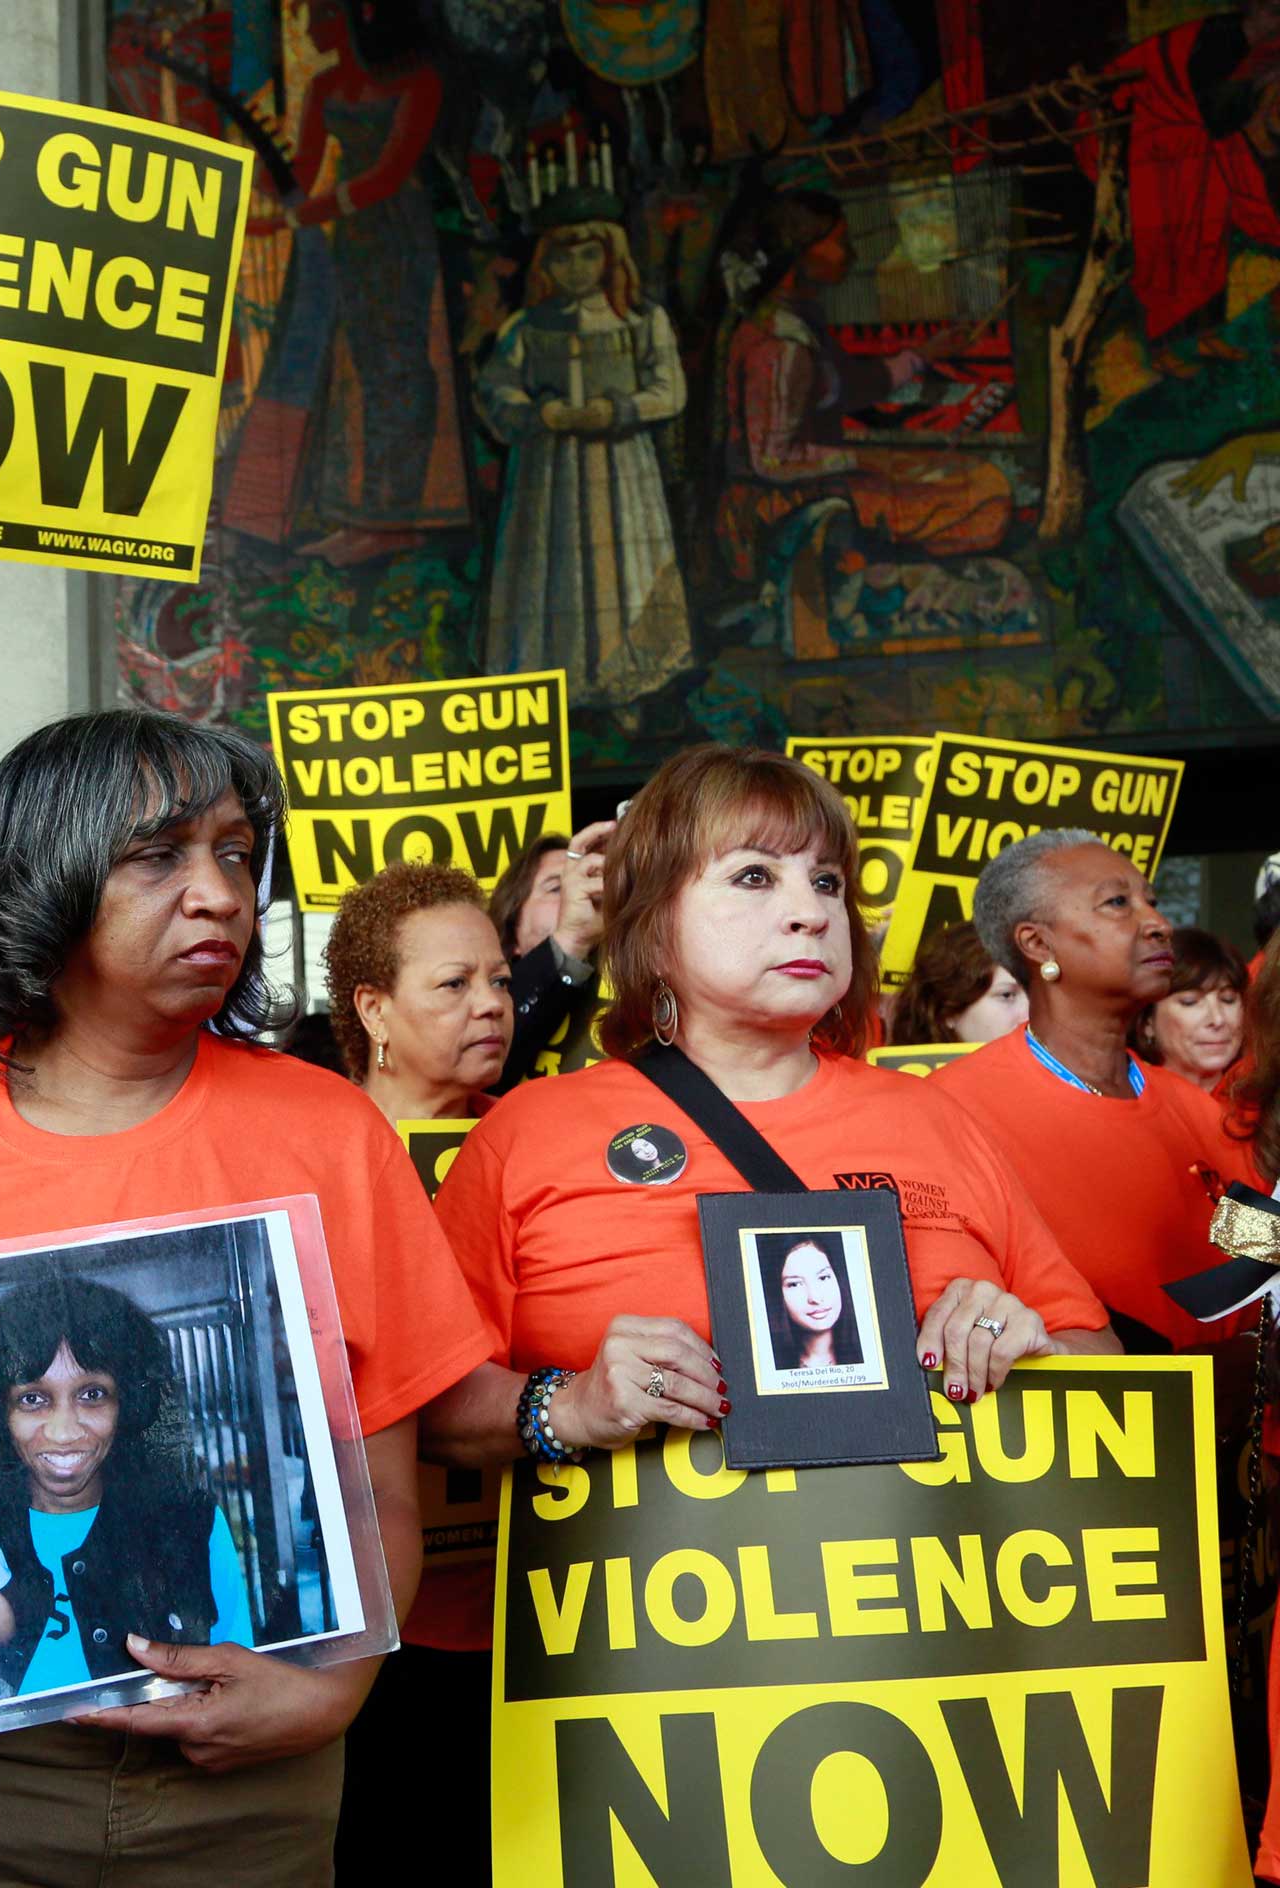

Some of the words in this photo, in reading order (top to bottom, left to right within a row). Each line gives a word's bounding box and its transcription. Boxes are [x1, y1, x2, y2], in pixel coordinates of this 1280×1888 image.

[35, 132, 223, 239] GUN
[37, 530, 176, 562] WWW.WAGV.ORG
[287, 698, 426, 745] STOP
[441, 686, 550, 735] GUN
[291, 741, 552, 797] VIOLENCE
[802, 748, 902, 784] STOP
[945, 752, 1082, 807] STOP
[1091, 769, 1169, 817] GUN
[312, 802, 549, 886] NOW
[899, 1179, 946, 1198] WOMEN
[904, 1192, 950, 1212] AGAINST
[781, 1377, 839, 1389] Shot/Murdered
[790, 1368, 814, 1377] Teresa
[815, 1367, 828, 1376] Del
[846, 1365, 855, 1373] 20
[527, 1527, 1167, 1656] VIOLENCE
[554, 1685, 1166, 1888] NOW
